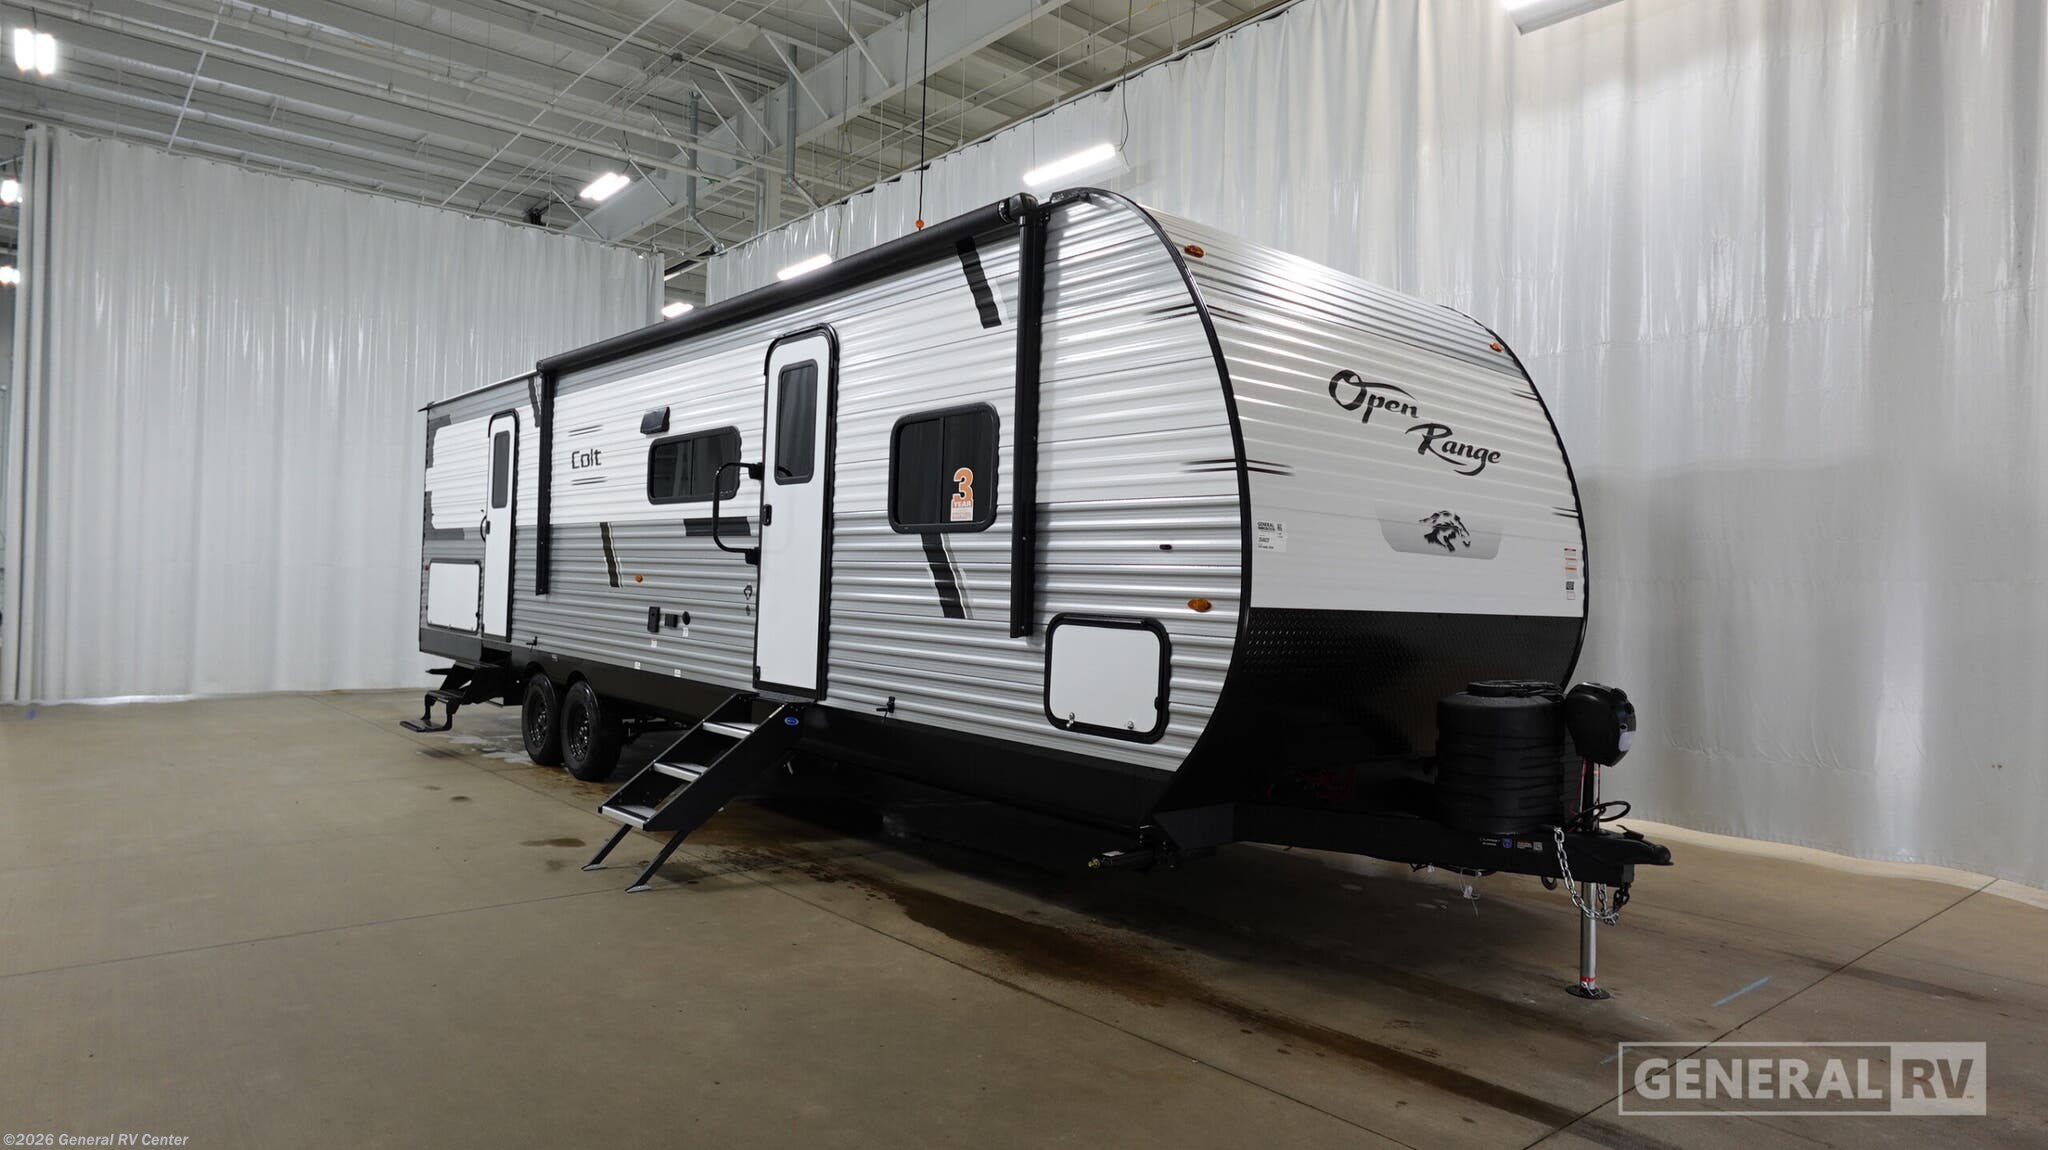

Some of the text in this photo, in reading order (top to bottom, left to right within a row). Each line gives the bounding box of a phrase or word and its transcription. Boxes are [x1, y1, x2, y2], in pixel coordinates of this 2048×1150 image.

[1328, 369, 1419, 424] Open
[571, 448, 602, 470] Colt
[1405, 422, 1501, 476] Range
[953, 467, 974, 501] 3
